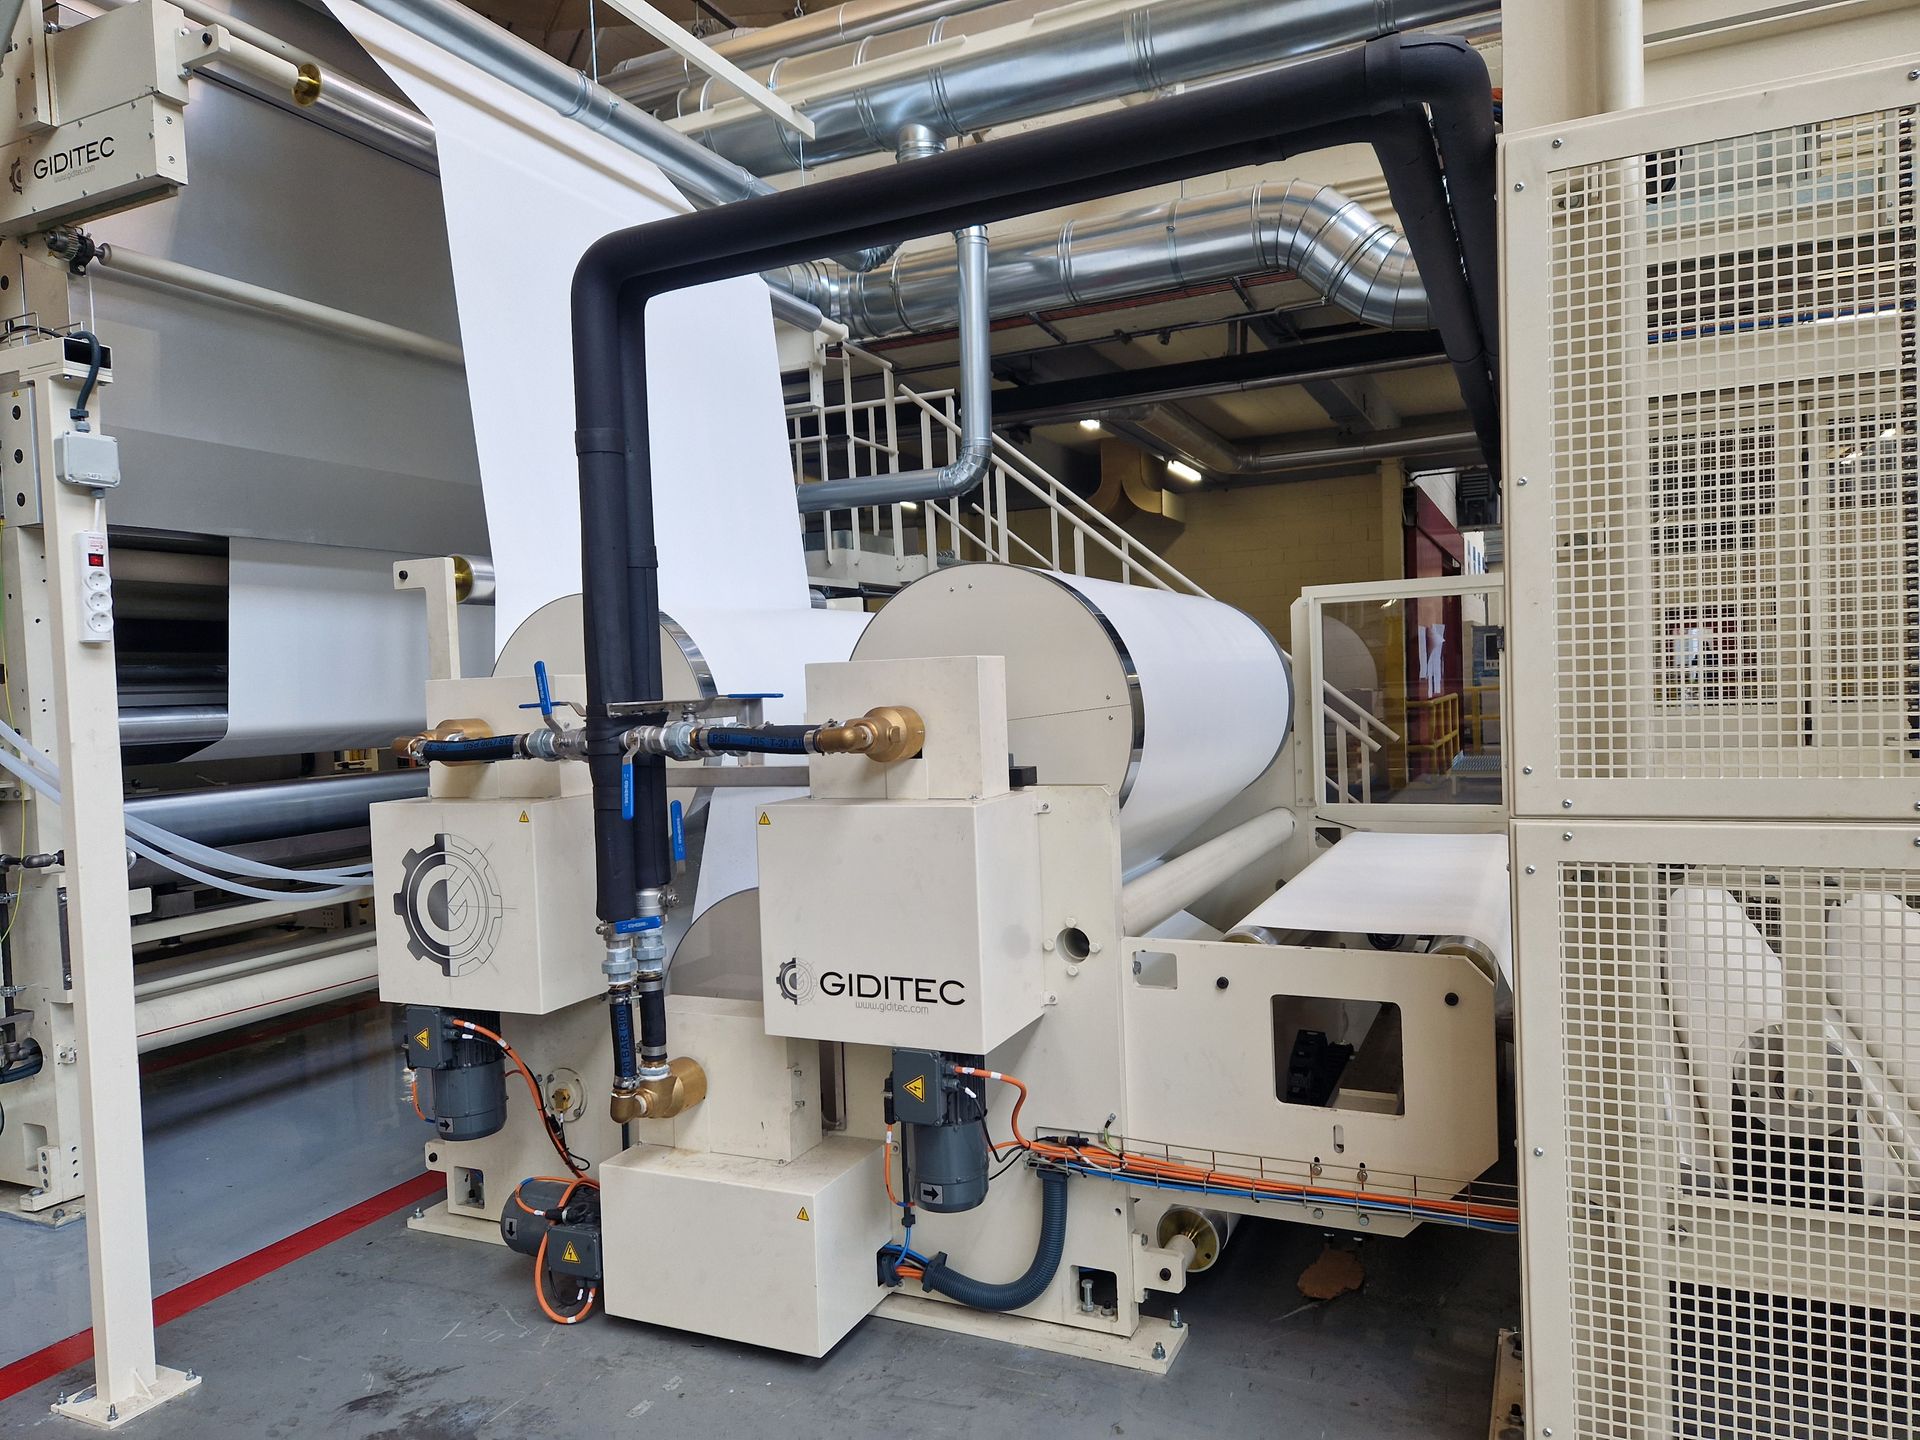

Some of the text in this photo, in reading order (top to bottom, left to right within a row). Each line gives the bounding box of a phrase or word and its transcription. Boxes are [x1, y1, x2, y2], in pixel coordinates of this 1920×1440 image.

[33, 136, 115, 180] GIDITEC
[819, 971, 966, 1006] GIDITEC
[855, 1001, 929, 1015] www.giditec.com
[620, 1034, 631, 1058] BAR
